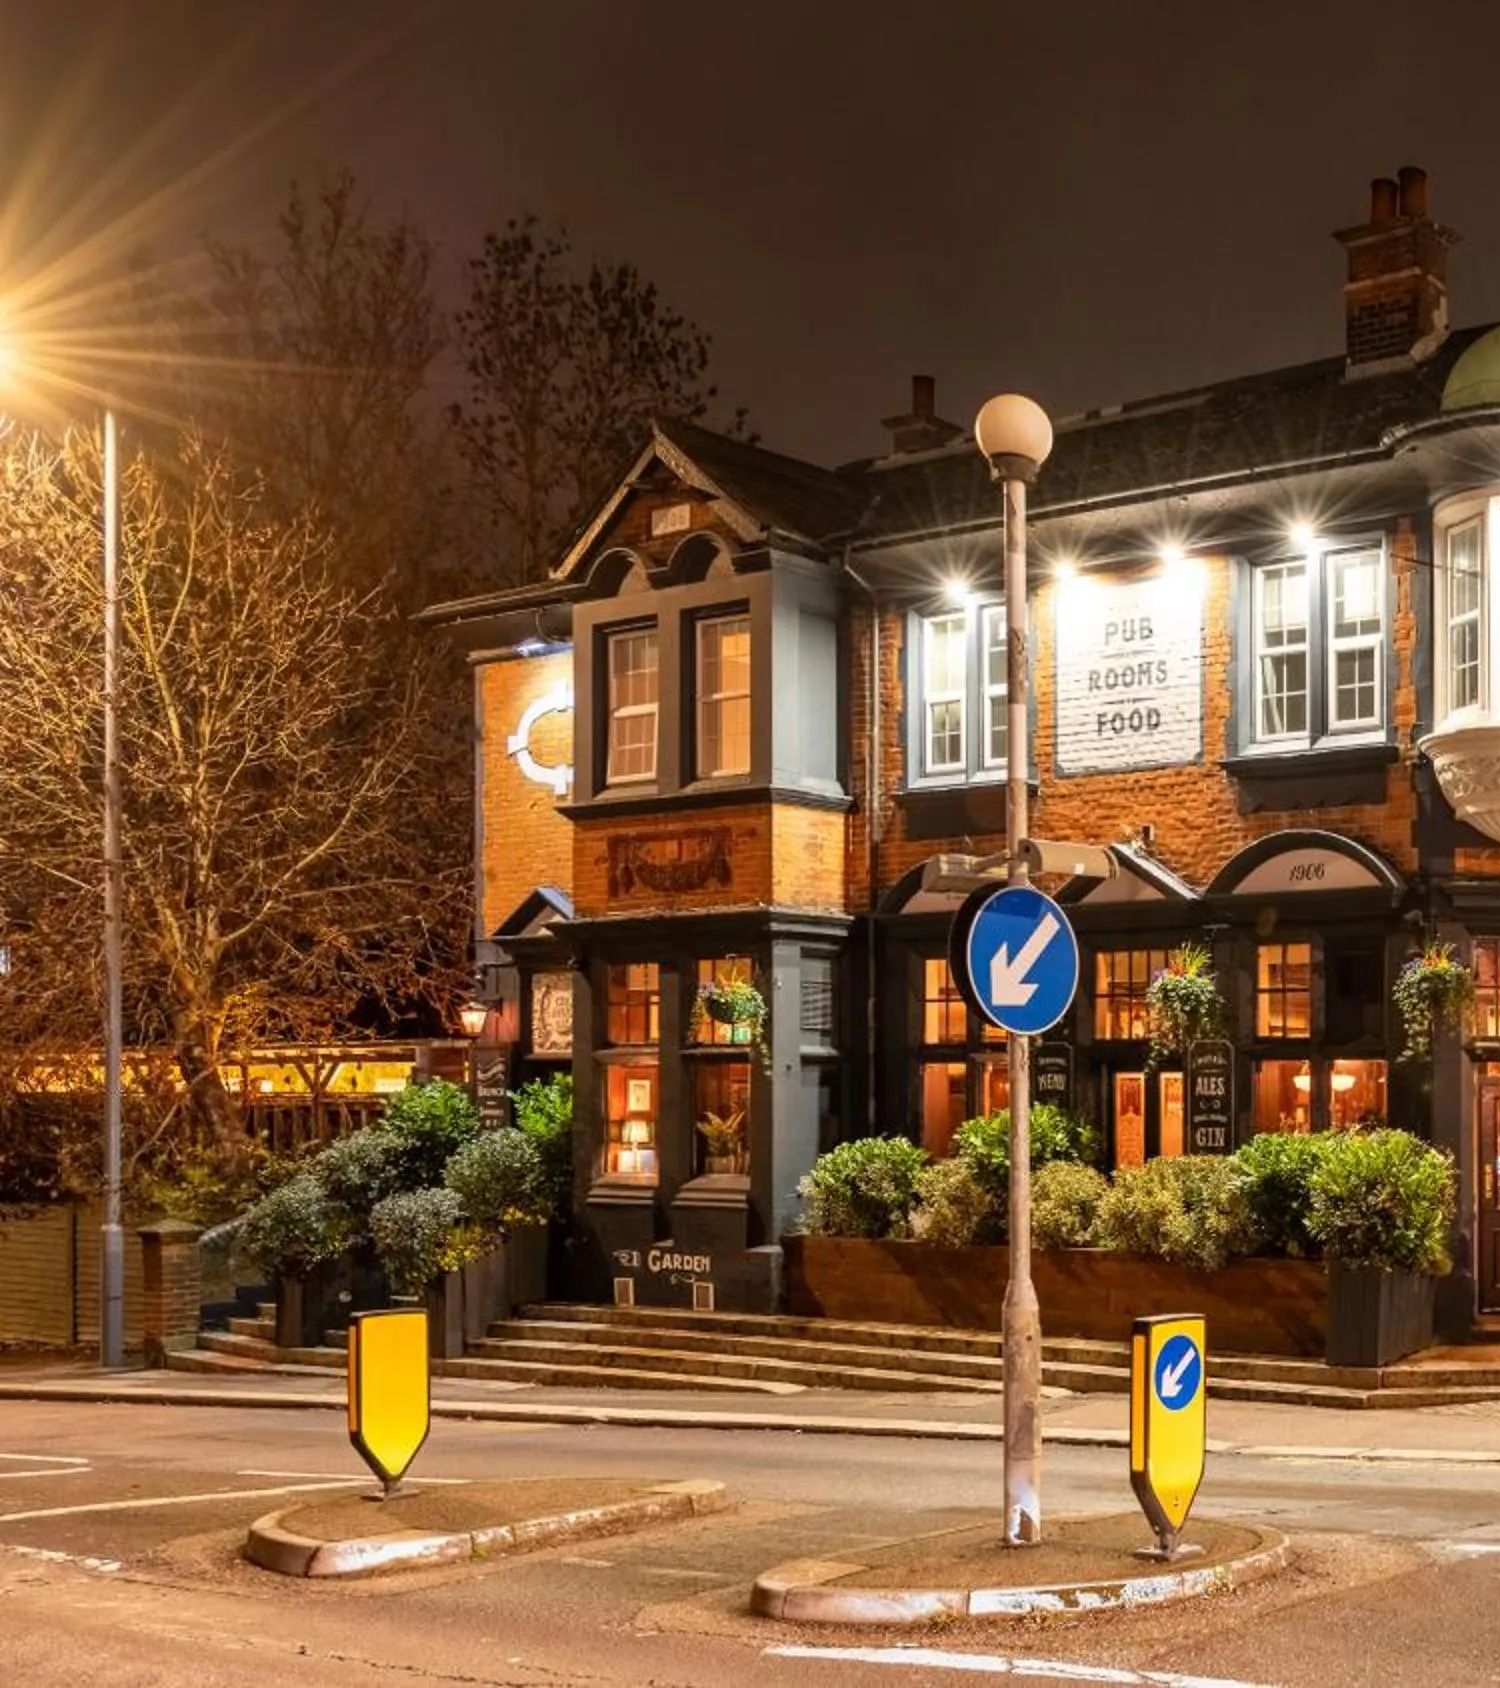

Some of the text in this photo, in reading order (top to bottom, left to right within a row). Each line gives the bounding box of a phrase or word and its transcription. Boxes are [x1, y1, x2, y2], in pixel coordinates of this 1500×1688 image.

[1104, 616, 1154, 646] PUB
[1088, 659, 1168, 692] ROOMS
[1097, 706, 1161, 737] FOOD
[1289, 862, 1325, 881] 1906
[1195, 1076, 1226, 1097] ALES
[1195, 1127, 1226, 1147] GIN
[647, 1249, 711, 1273] GARDEN
